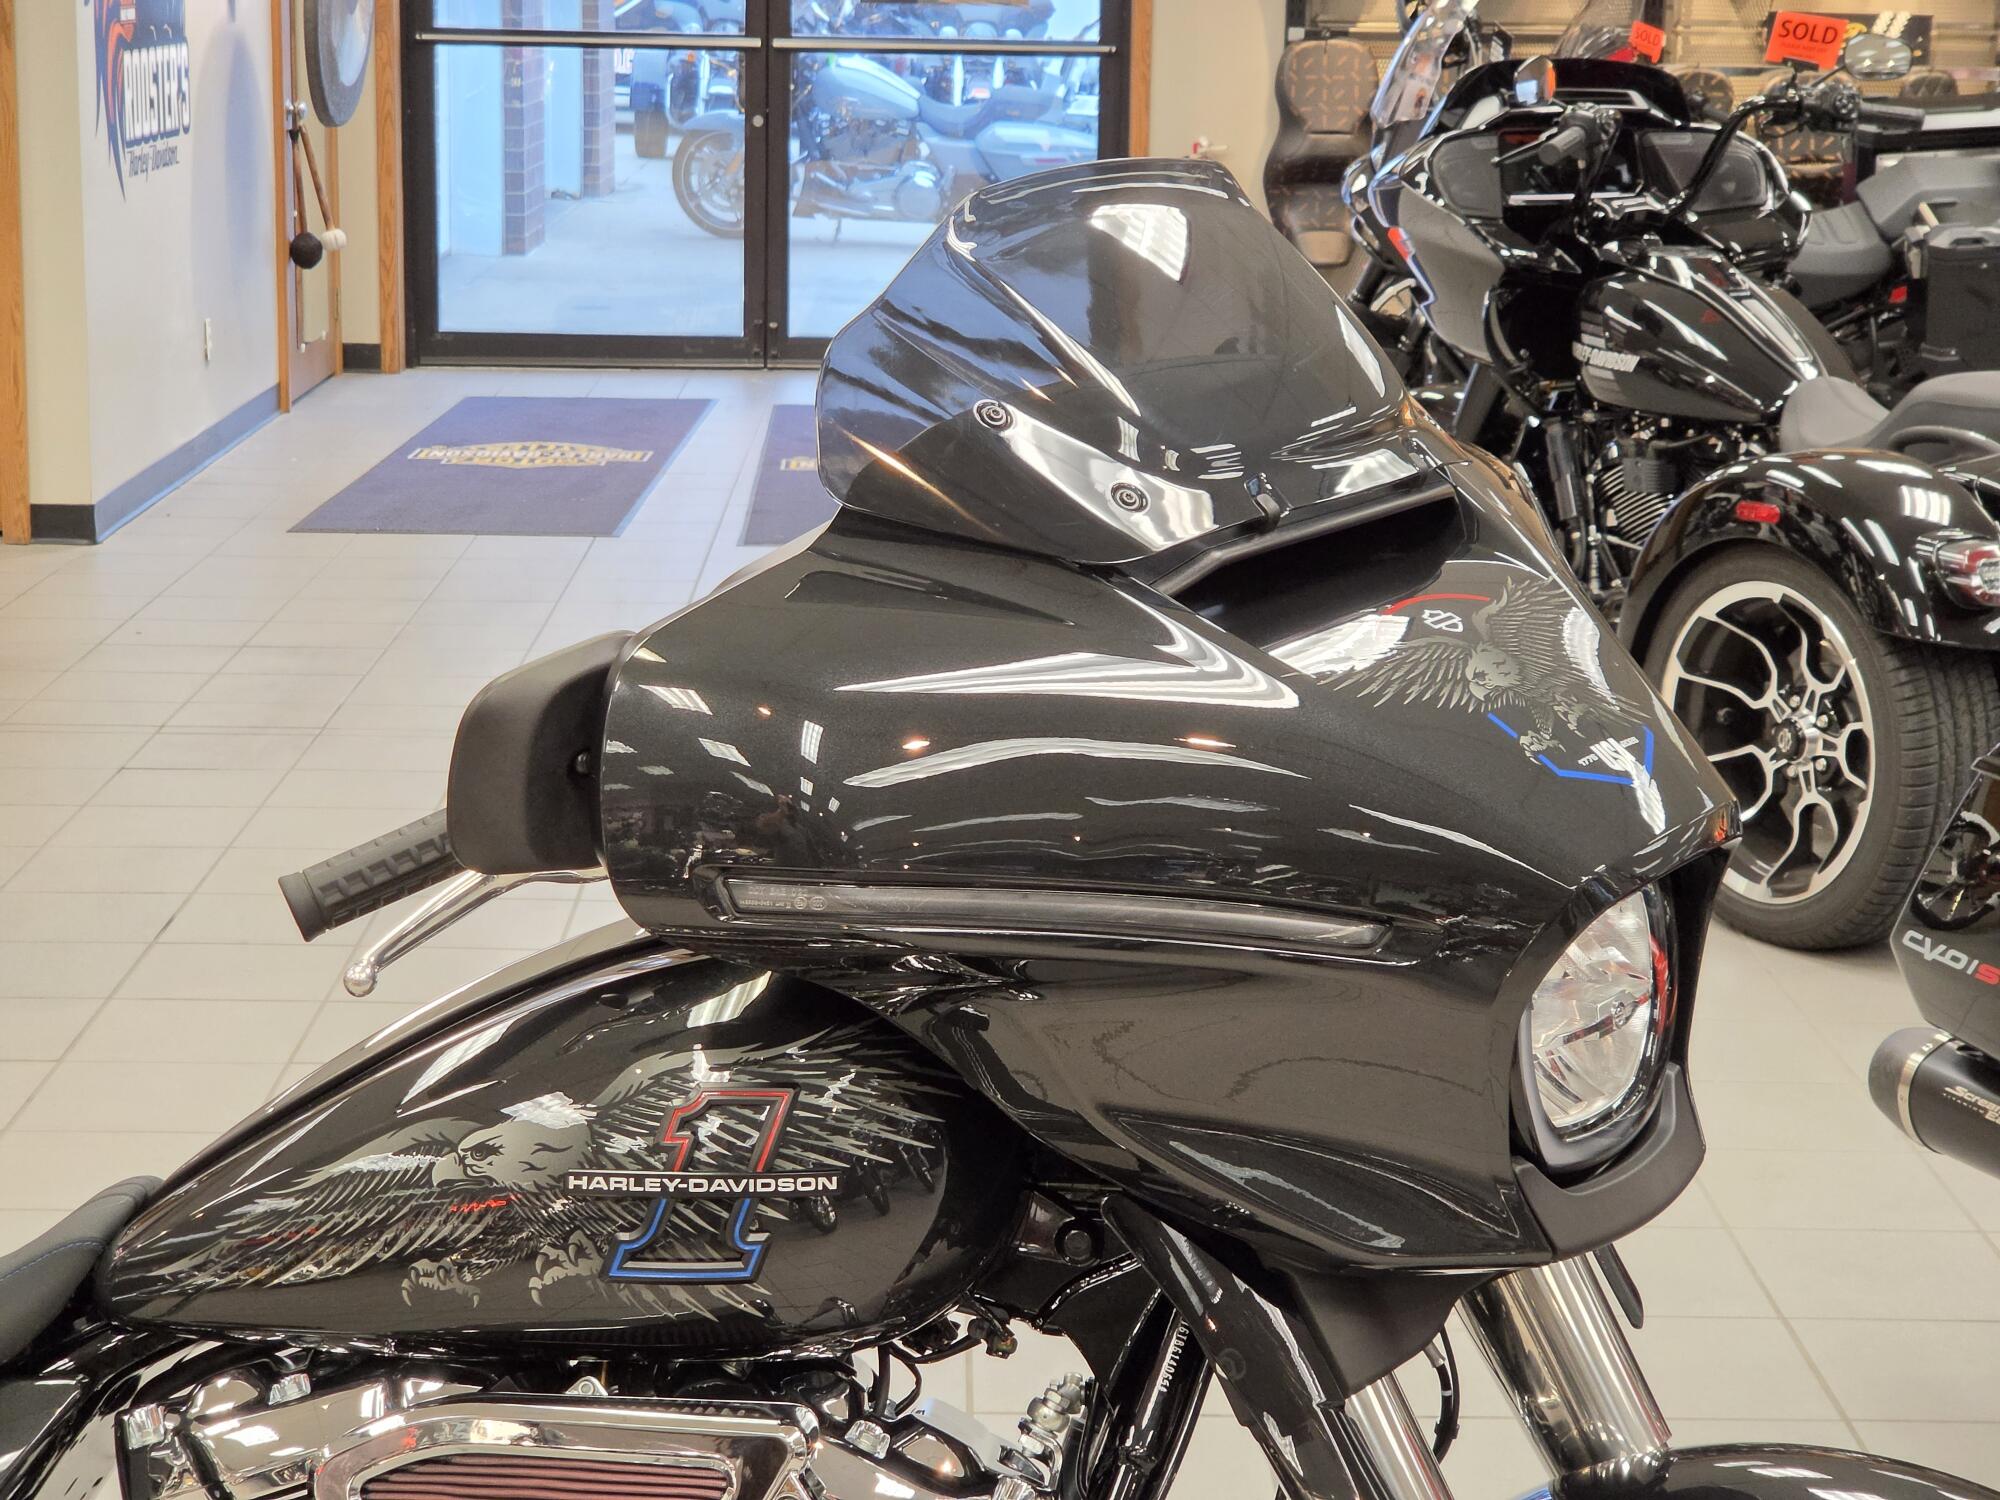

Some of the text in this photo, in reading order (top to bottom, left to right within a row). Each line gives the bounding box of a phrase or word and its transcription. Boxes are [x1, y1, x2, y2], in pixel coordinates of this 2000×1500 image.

[1635, 30, 1660, 46] SOLD
[1779, 19, 1838, 45] SOLD
[123, 42, 190, 145] ROOSTER'S
[1578, 753, 1599, 767] 1776
[1589, 737, 1637, 771] USA
[568, 1175, 838, 1194] HARLEY-DAVIDSON
